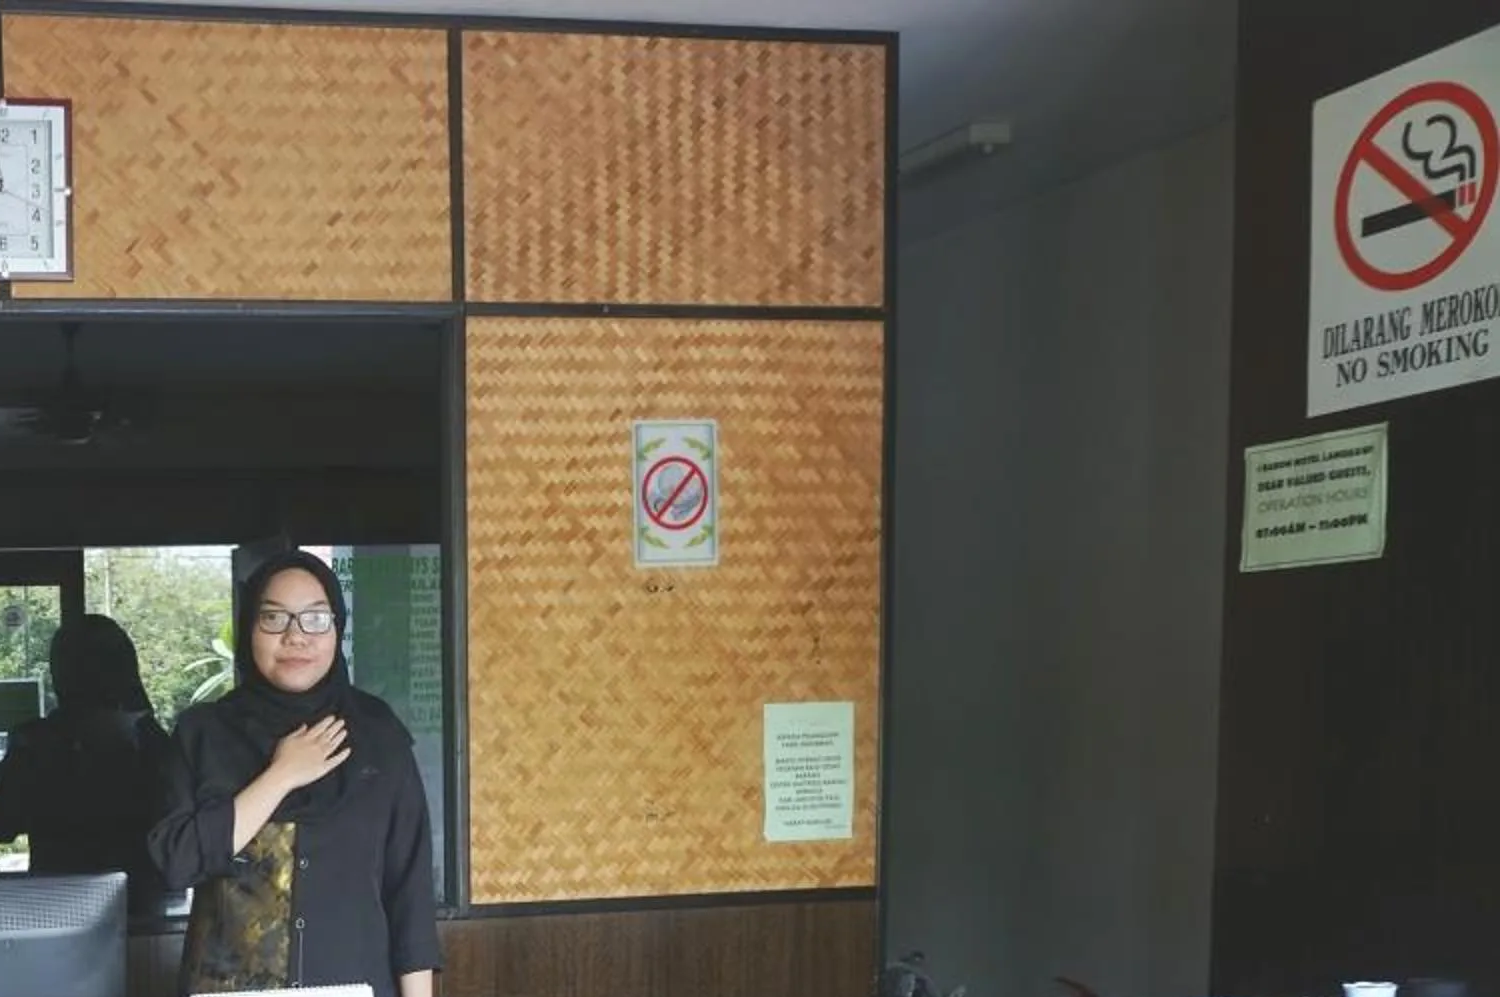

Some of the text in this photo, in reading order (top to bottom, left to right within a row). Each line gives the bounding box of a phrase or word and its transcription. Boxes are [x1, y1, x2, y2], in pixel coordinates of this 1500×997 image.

[1322, 285, 1500, 359] DILARANG MEROKO
[1335, 328, 1489, 388] NO SMOKING
